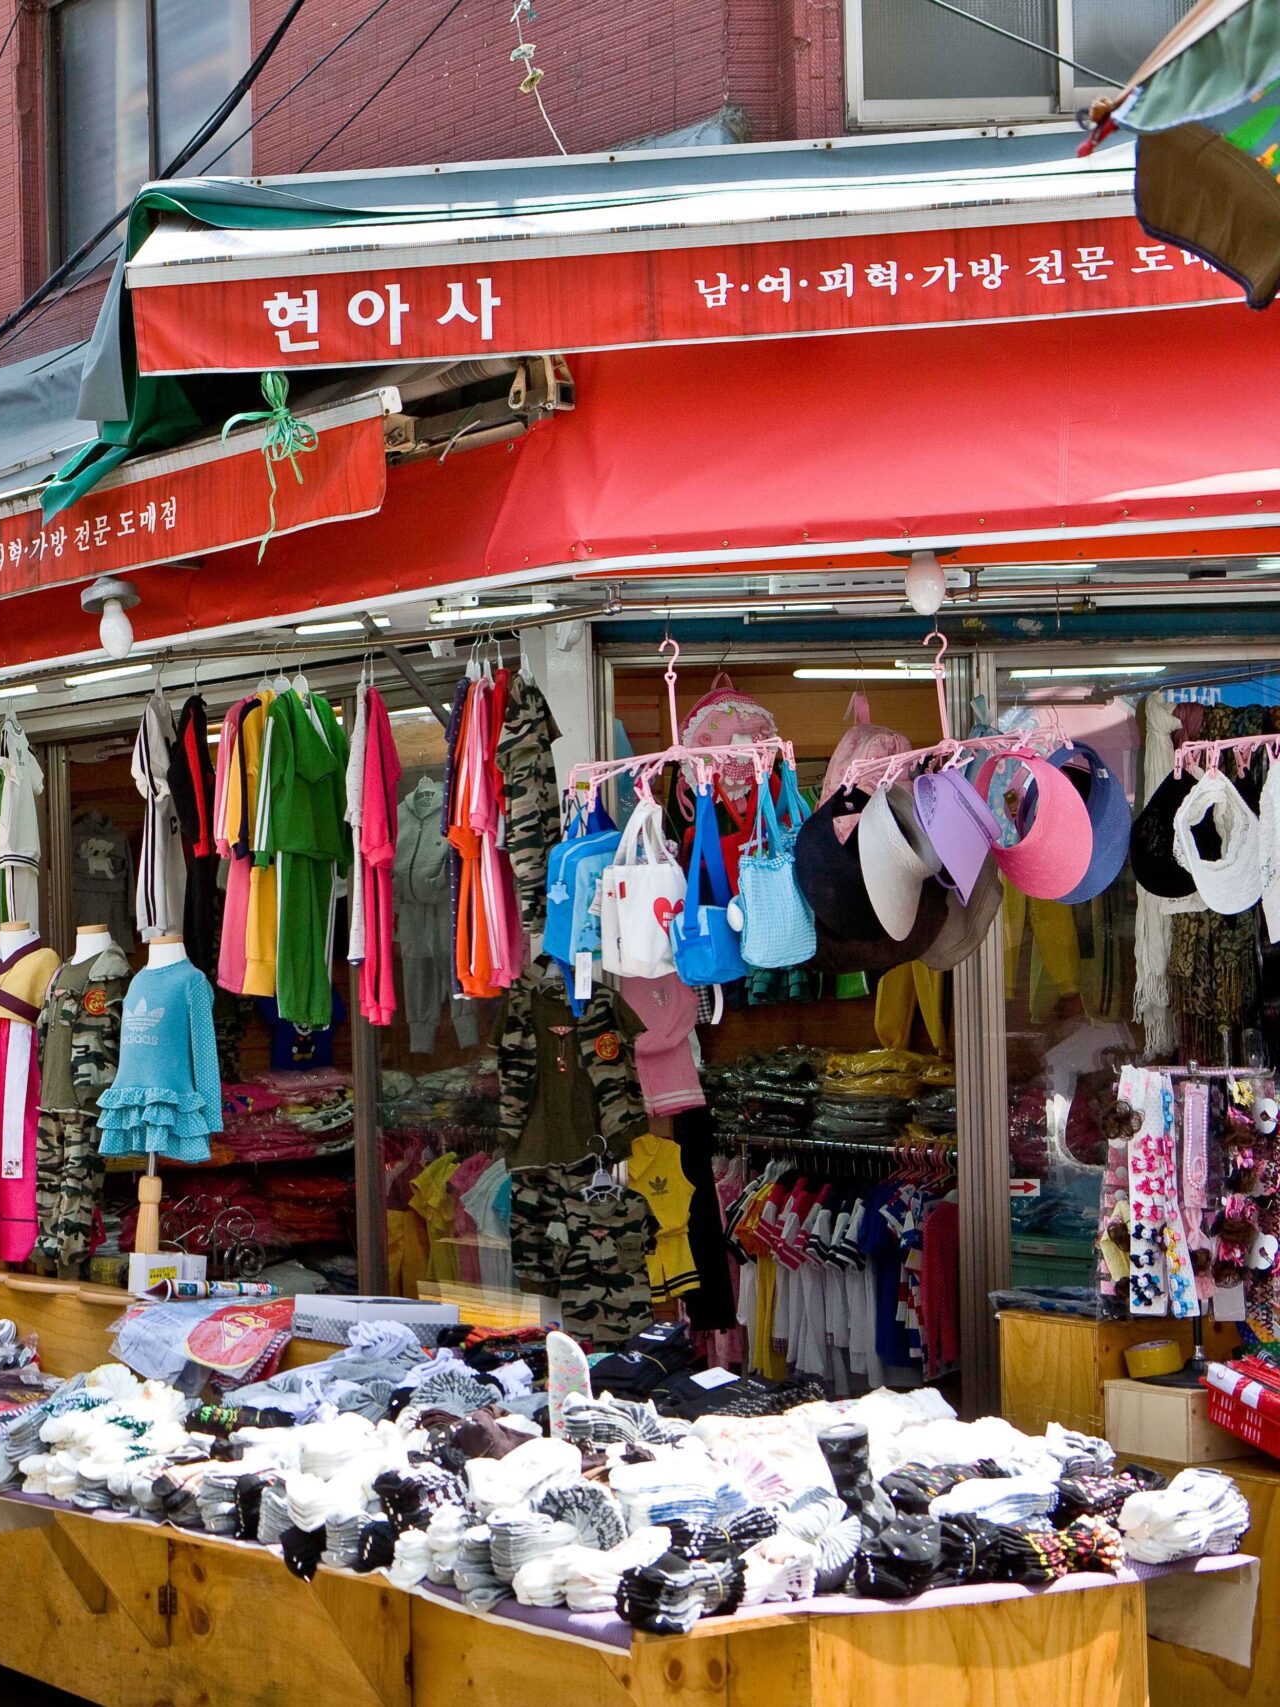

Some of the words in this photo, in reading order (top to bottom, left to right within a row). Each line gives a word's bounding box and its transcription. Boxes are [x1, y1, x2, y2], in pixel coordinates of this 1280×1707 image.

[1025, 244, 1116, 286] 전문
[73, 514, 112, 552] 전문
[116, 496, 177, 538] 도매점
